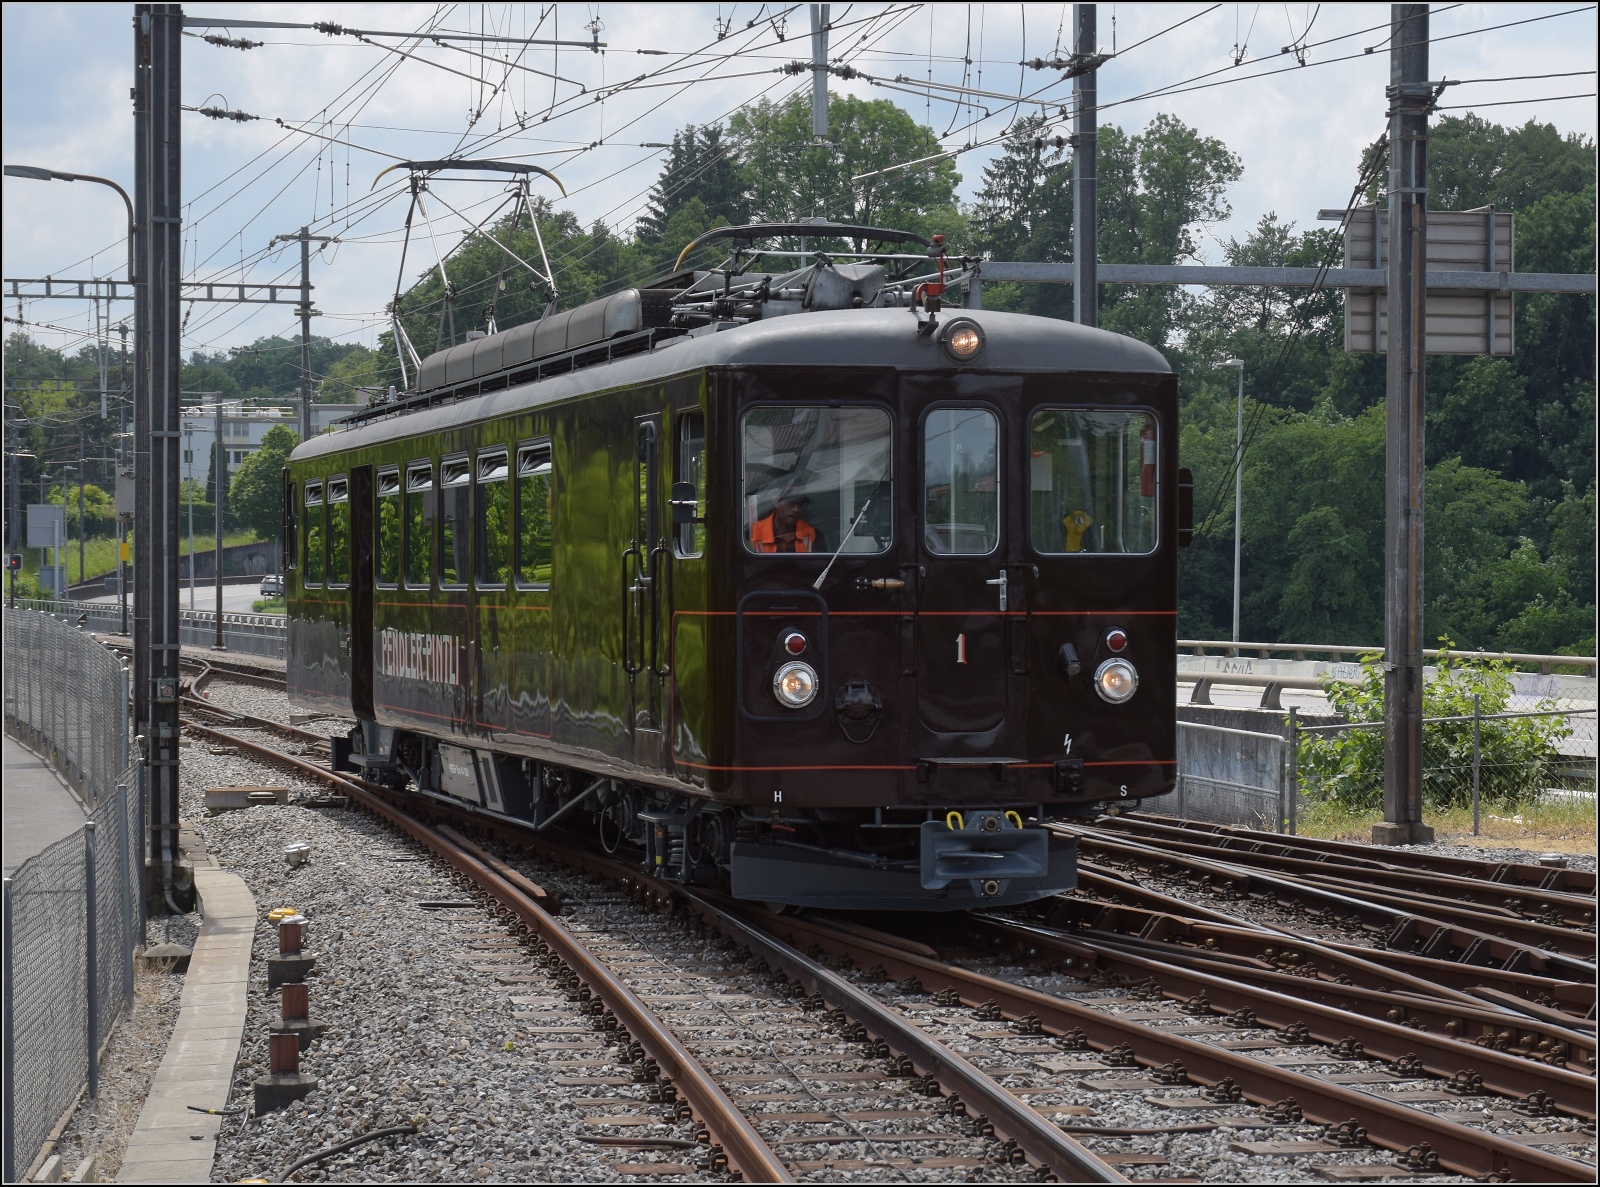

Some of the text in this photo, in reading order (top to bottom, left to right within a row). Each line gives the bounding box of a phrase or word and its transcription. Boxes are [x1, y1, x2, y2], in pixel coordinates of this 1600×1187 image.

[381, 629, 460, 686] PENDLER-PINTLI
[955, 633, 967, 664] 1
[774, 790, 782, 803] H
[1120, 785, 1127, 797] S
